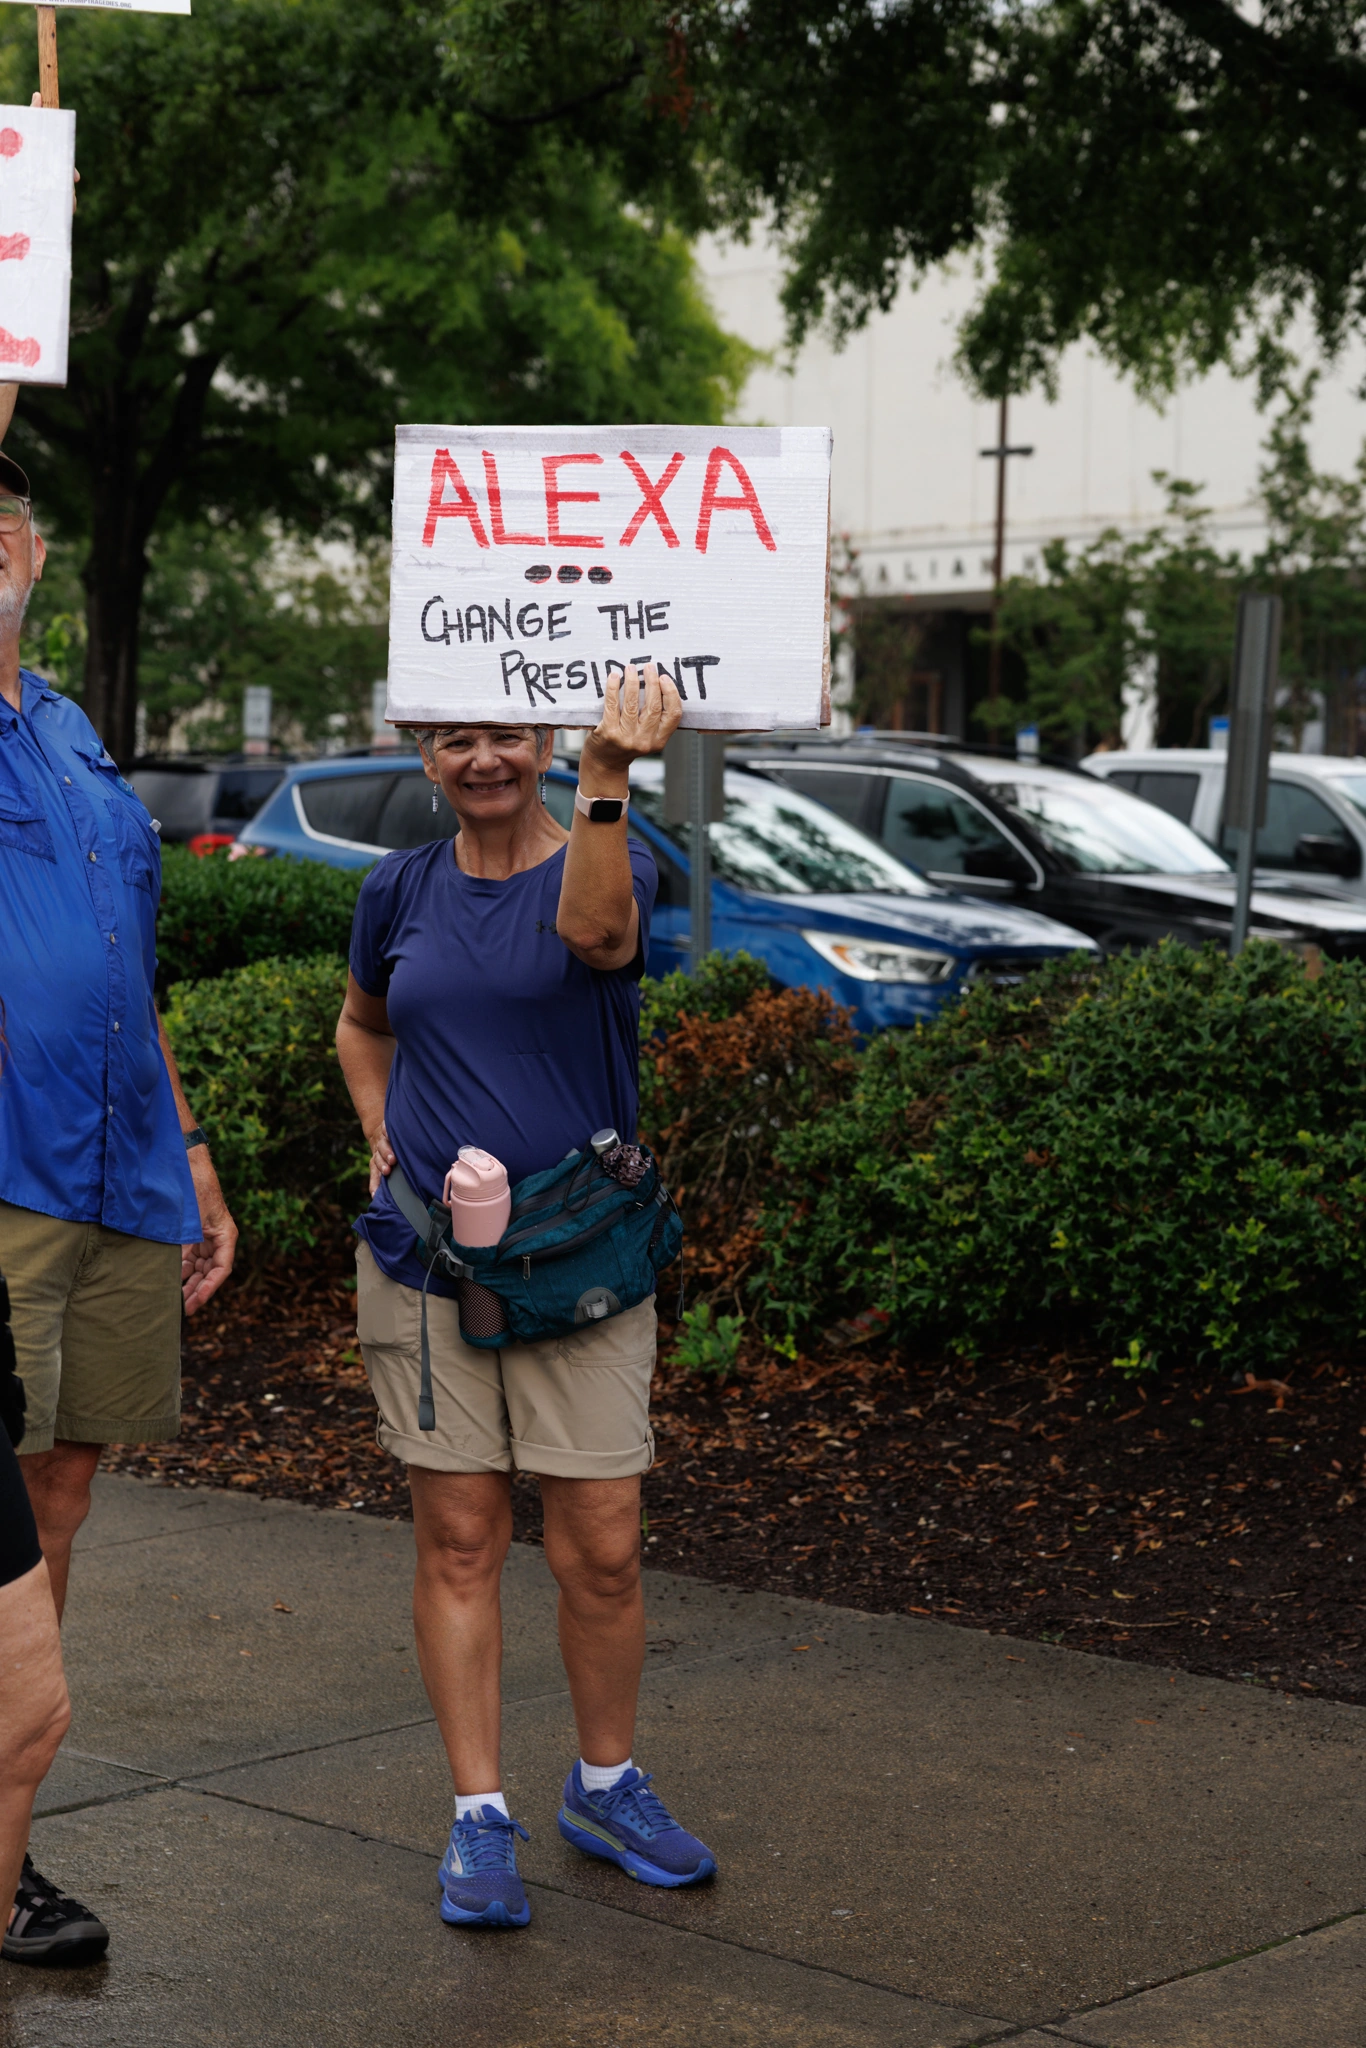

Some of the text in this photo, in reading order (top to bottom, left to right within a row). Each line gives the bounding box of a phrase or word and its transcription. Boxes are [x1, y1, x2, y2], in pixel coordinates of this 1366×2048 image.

[422, 446, 777, 555] ALEXA
[421, 595, 671, 646] CHANGE THE
